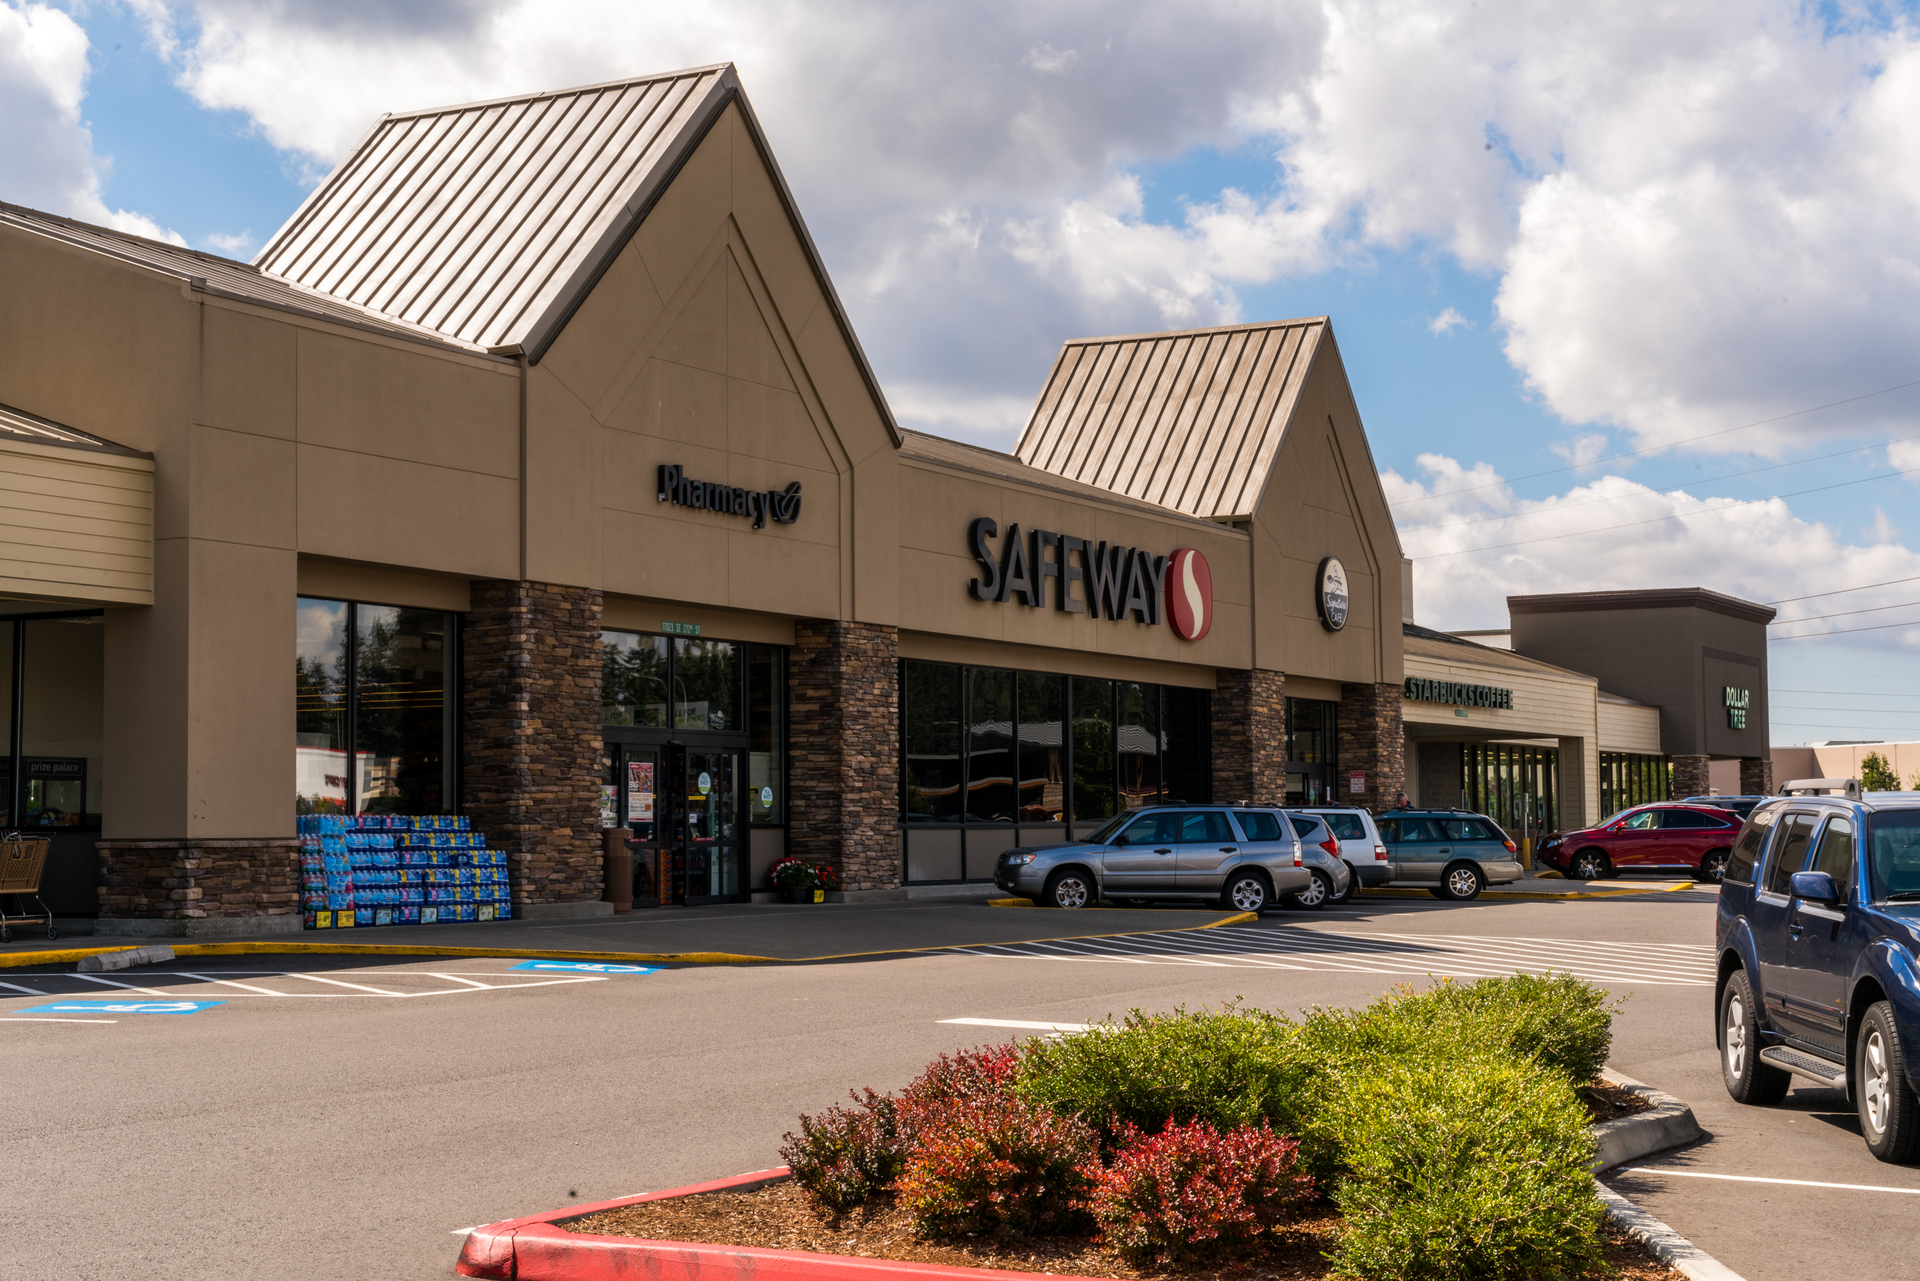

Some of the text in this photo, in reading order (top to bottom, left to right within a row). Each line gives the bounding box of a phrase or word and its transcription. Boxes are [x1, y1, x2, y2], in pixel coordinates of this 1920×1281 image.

[658, 464, 771, 529] Pharmacy
[968, 517, 1169, 626] SAFEWAY
[675, 622, 682, 633] SE
[1405, 677, 1514, 710] STARBUCKS COFFEE
[1725, 686, 1749, 708] DOLLAR
[1729, 708, 1746, 729] TREE
[31, 762, 79, 774] prize palace
